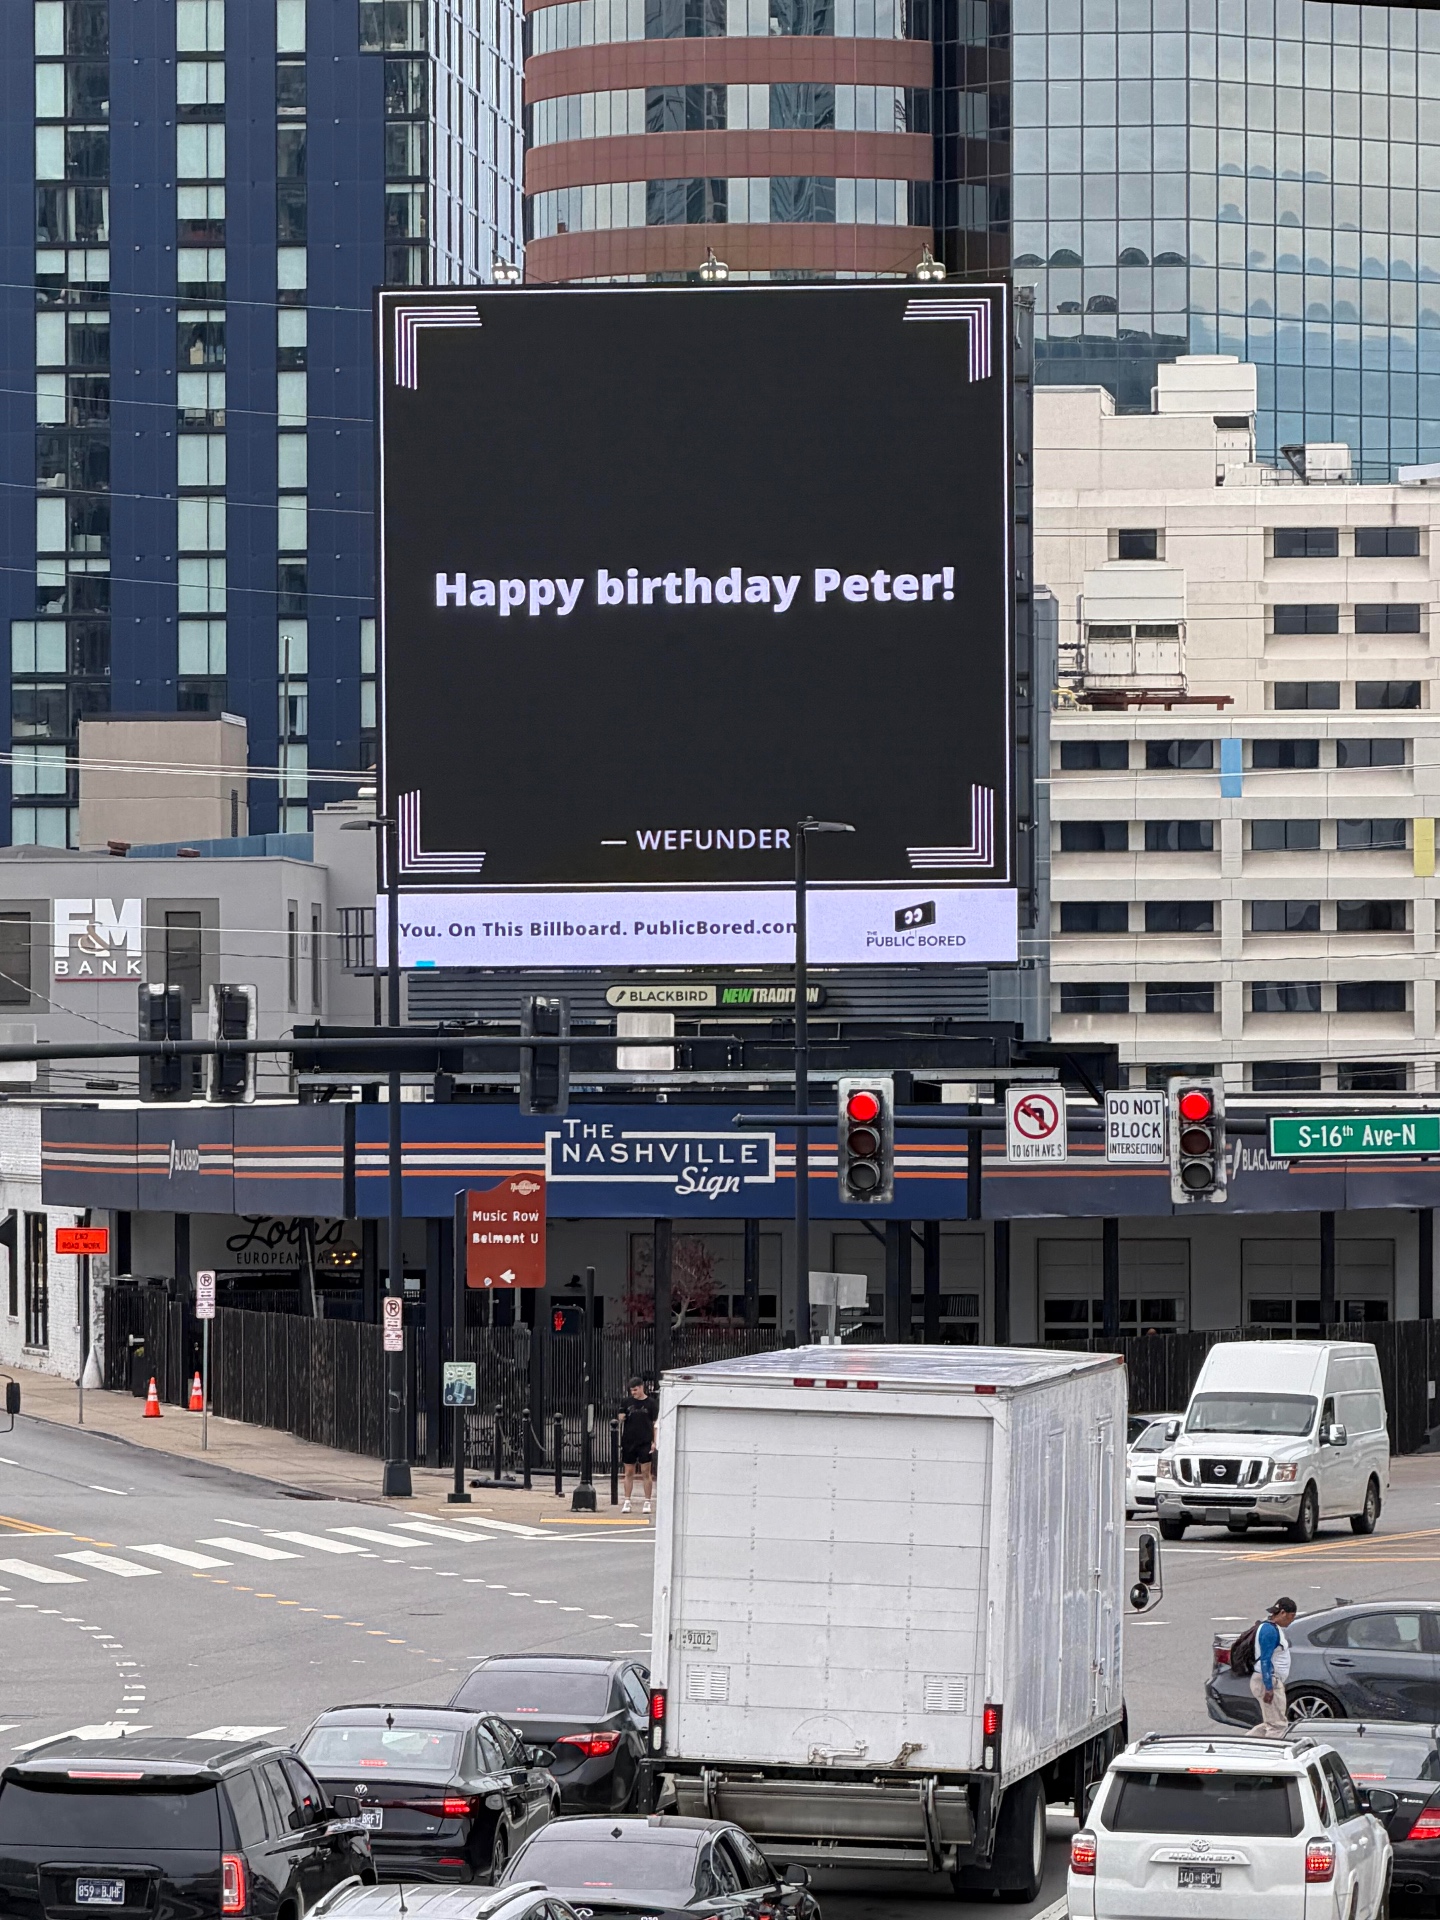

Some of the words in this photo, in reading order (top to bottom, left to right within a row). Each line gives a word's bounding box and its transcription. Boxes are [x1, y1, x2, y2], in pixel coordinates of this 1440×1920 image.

[436, 572, 584, 616] Happy
[598, 567, 801, 613] birthday
[815, 567, 955, 602] Peter!
[636, 829, 791, 850] WEFUNDER
[400, 923, 442, 937] You.
[449, 923, 476, 937] On
[482, 922, 523, 937] This
[530, 921, 627, 937] Billboard.
[867, 936, 915, 947] PUBLIC
[918, 935, 966, 947] BORED
[55, 960, 142, 975] BANK
[630, 990, 708, 1002] BLACKBIRD
[1110, 1100, 1129, 1115] DO
[1134, 1100, 1161, 1115] NOT
[562, 1119, 614, 1139] THE
[1110, 1122, 1162, 1138] BLOCK
[1298, 1125, 1354, 1148] S-16th
[1362, 1123, 1416, 1146] Ave-N
[562, 1143, 758, 1164] NASHVILLE
[1012, 1145, 1021, 1158] TO
[1023, 1144, 1040, 1158] 16TH
[1042, 1144, 1055, 1157] AVE
[1057, 1144, 1062, 1157] S
[1110, 1143, 1162, 1155] INTERSECTION
[675, 1165, 740, 1200] Sign
[472, 1209, 508, 1221] Music
[513, 1210, 539, 1222] Row
[472, 1232, 525, 1243] Belmont
[530, 1233, 539, 1244] U
